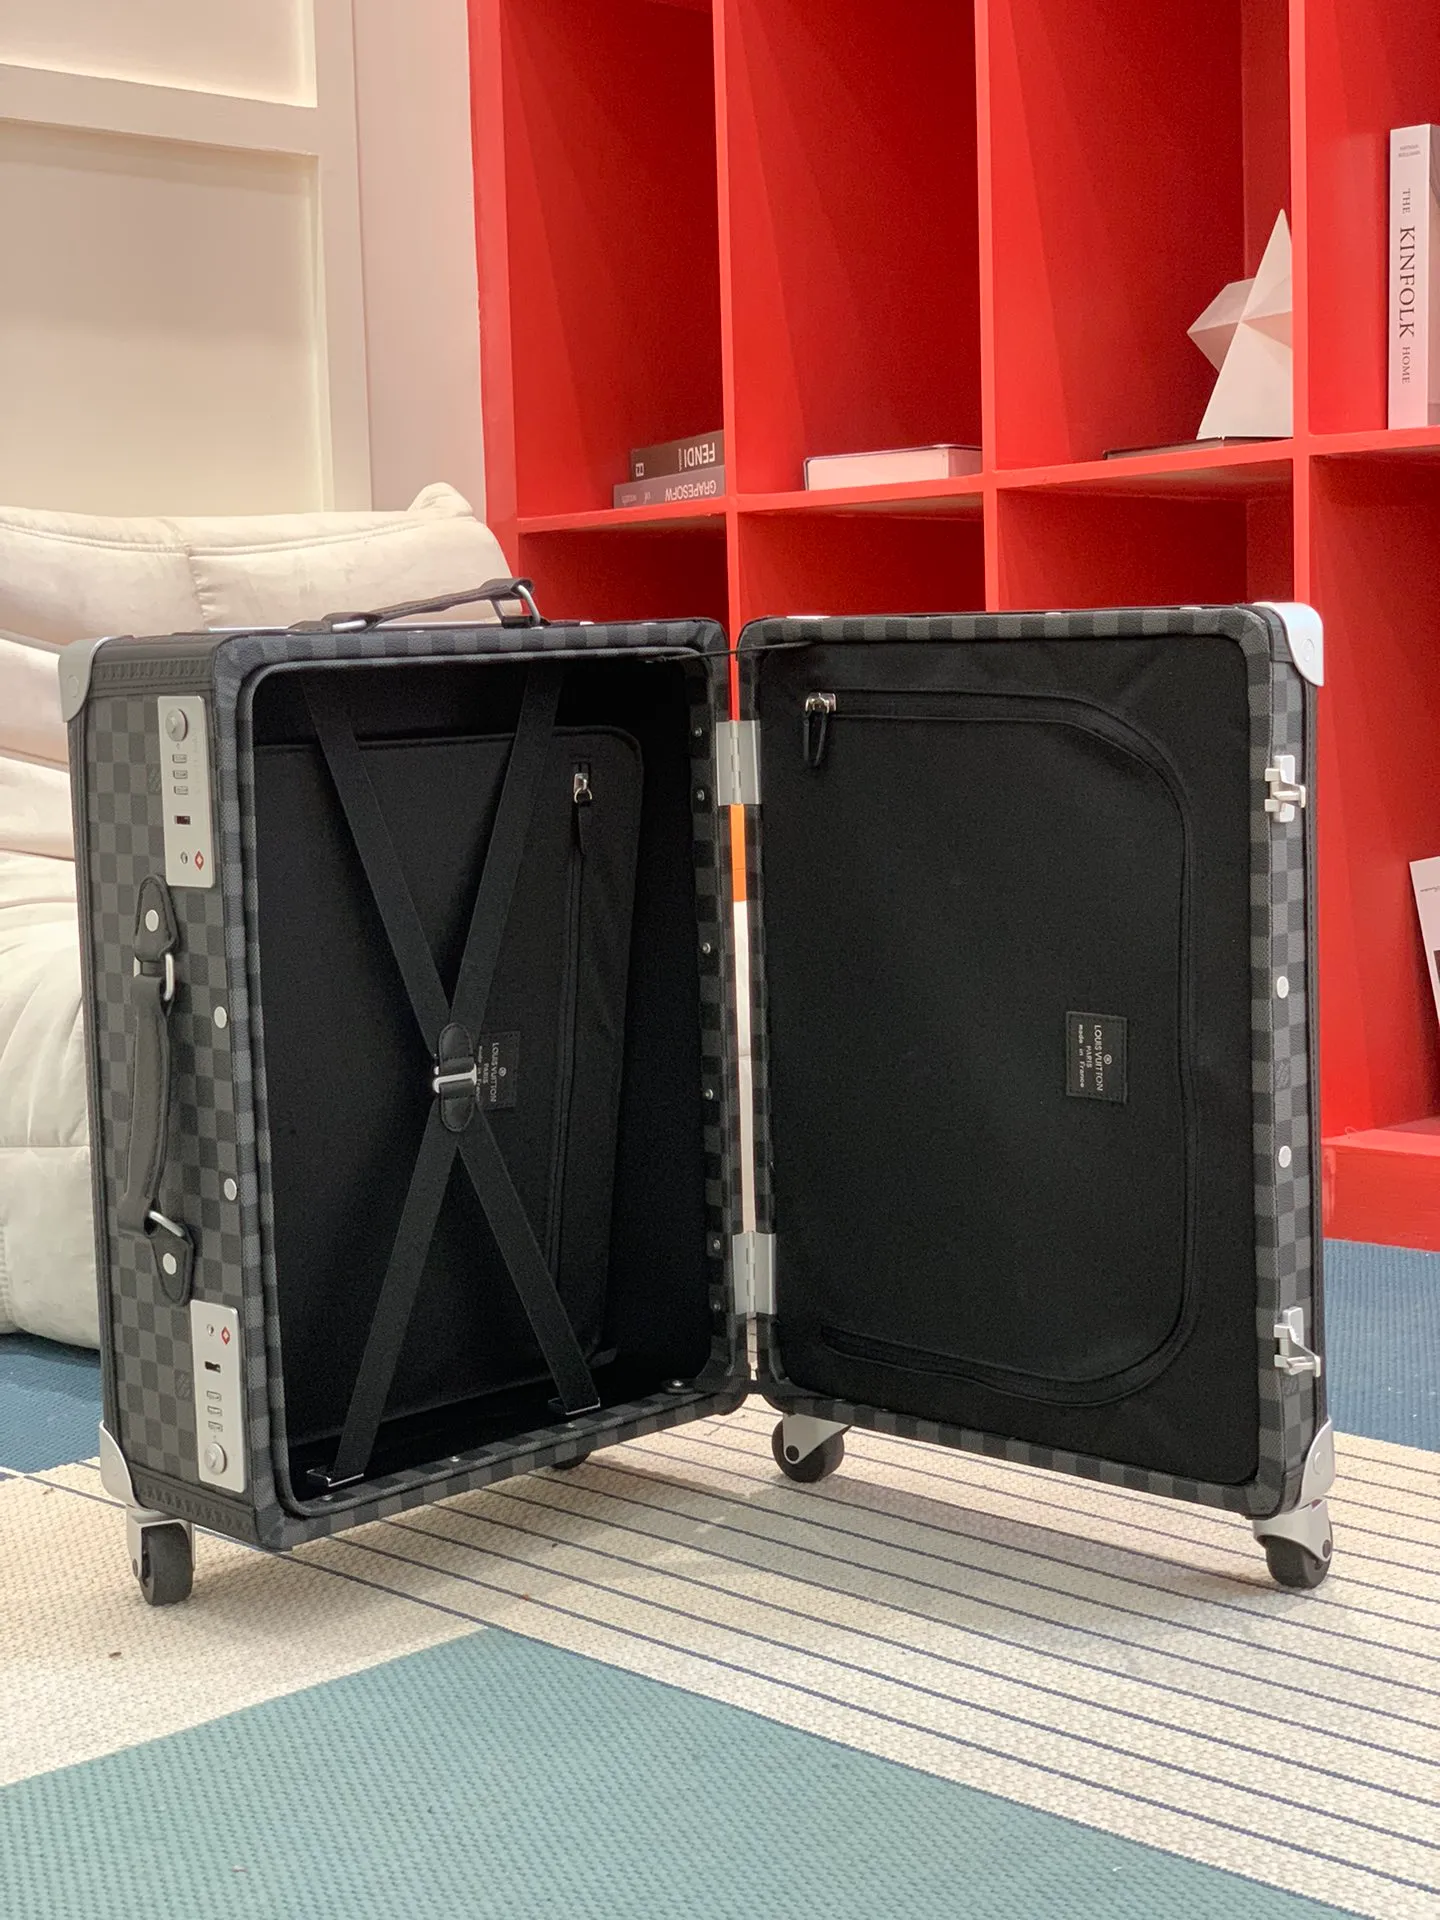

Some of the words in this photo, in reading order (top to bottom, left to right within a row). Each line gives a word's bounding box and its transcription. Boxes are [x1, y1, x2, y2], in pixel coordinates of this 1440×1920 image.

[1402, 187, 1411, 214] THE
[1399, 226, 1415, 338] KINFOLK
[1402, 346, 1411, 384] HOME
[684, 442, 716, 468] FENDI
[1094, 1025, 1102, 1051] LOUIS
[1085, 1045, 1093, 1068] PARIS
[1095, 1052, 1103, 1091] VUITTON
[490, 1067, 498, 1102] VUITTON
